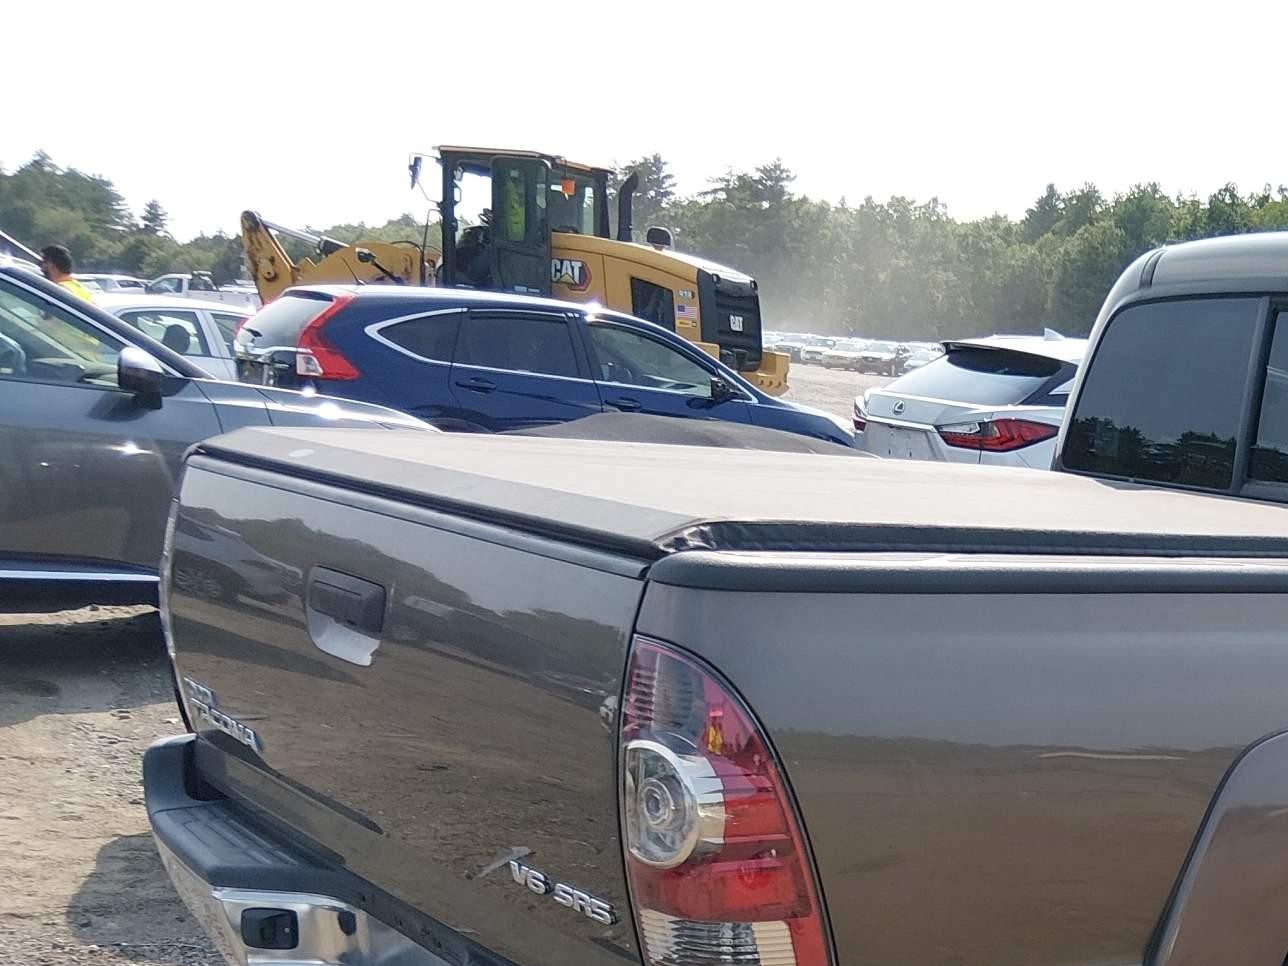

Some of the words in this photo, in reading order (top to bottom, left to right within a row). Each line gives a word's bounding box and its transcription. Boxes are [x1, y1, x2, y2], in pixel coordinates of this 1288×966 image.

[551, 258, 582, 285] CAT
[729, 314, 743, 332] CAT
[509, 860, 549, 895] V6
[553, 883, 614, 925] SR5
